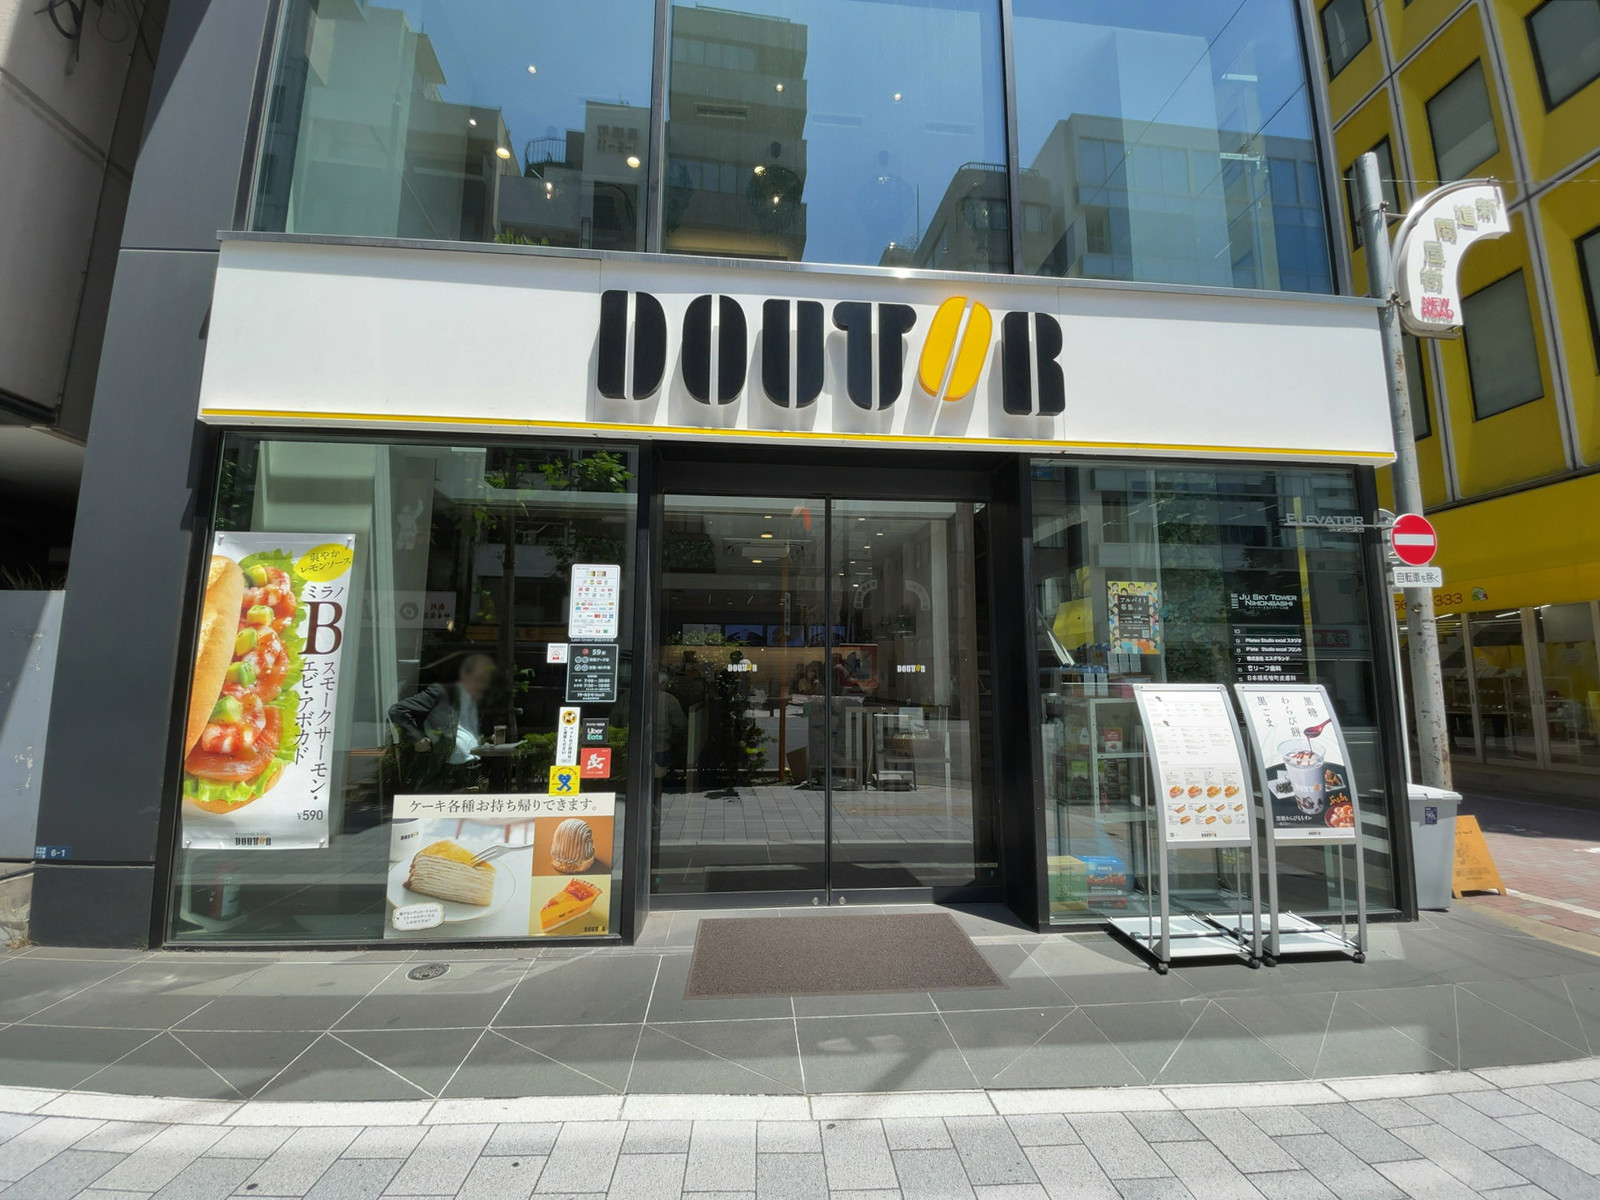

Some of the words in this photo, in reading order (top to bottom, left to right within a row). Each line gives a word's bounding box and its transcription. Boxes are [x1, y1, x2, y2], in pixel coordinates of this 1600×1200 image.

[1421, 296, 1450, 308] NEW
[1421, 307, 1454, 321] ROAD
[597, 289, 1065, 417] DOUTOR
[1286, 513, 1364, 525] ELEVATOR
[310, 550, 340, 563] 爽やか
[300, 557, 351, 573] レモンソース
[1397, 572, 1440, 584] 自転車を除く
[308, 585, 344, 600] ミラノ
[297, 601, 344, 655] B
[727, 664, 758, 672] DOUTOR
[897, 664, 926, 673] DOUTOR
[409, 798, 598, 813] ケーキ各種お持ち帰りできます。
[297, 809, 323, 822] ¥590
[235, 837, 272, 846] DOUTOR
[50, 849, 66, 857] 6-1
